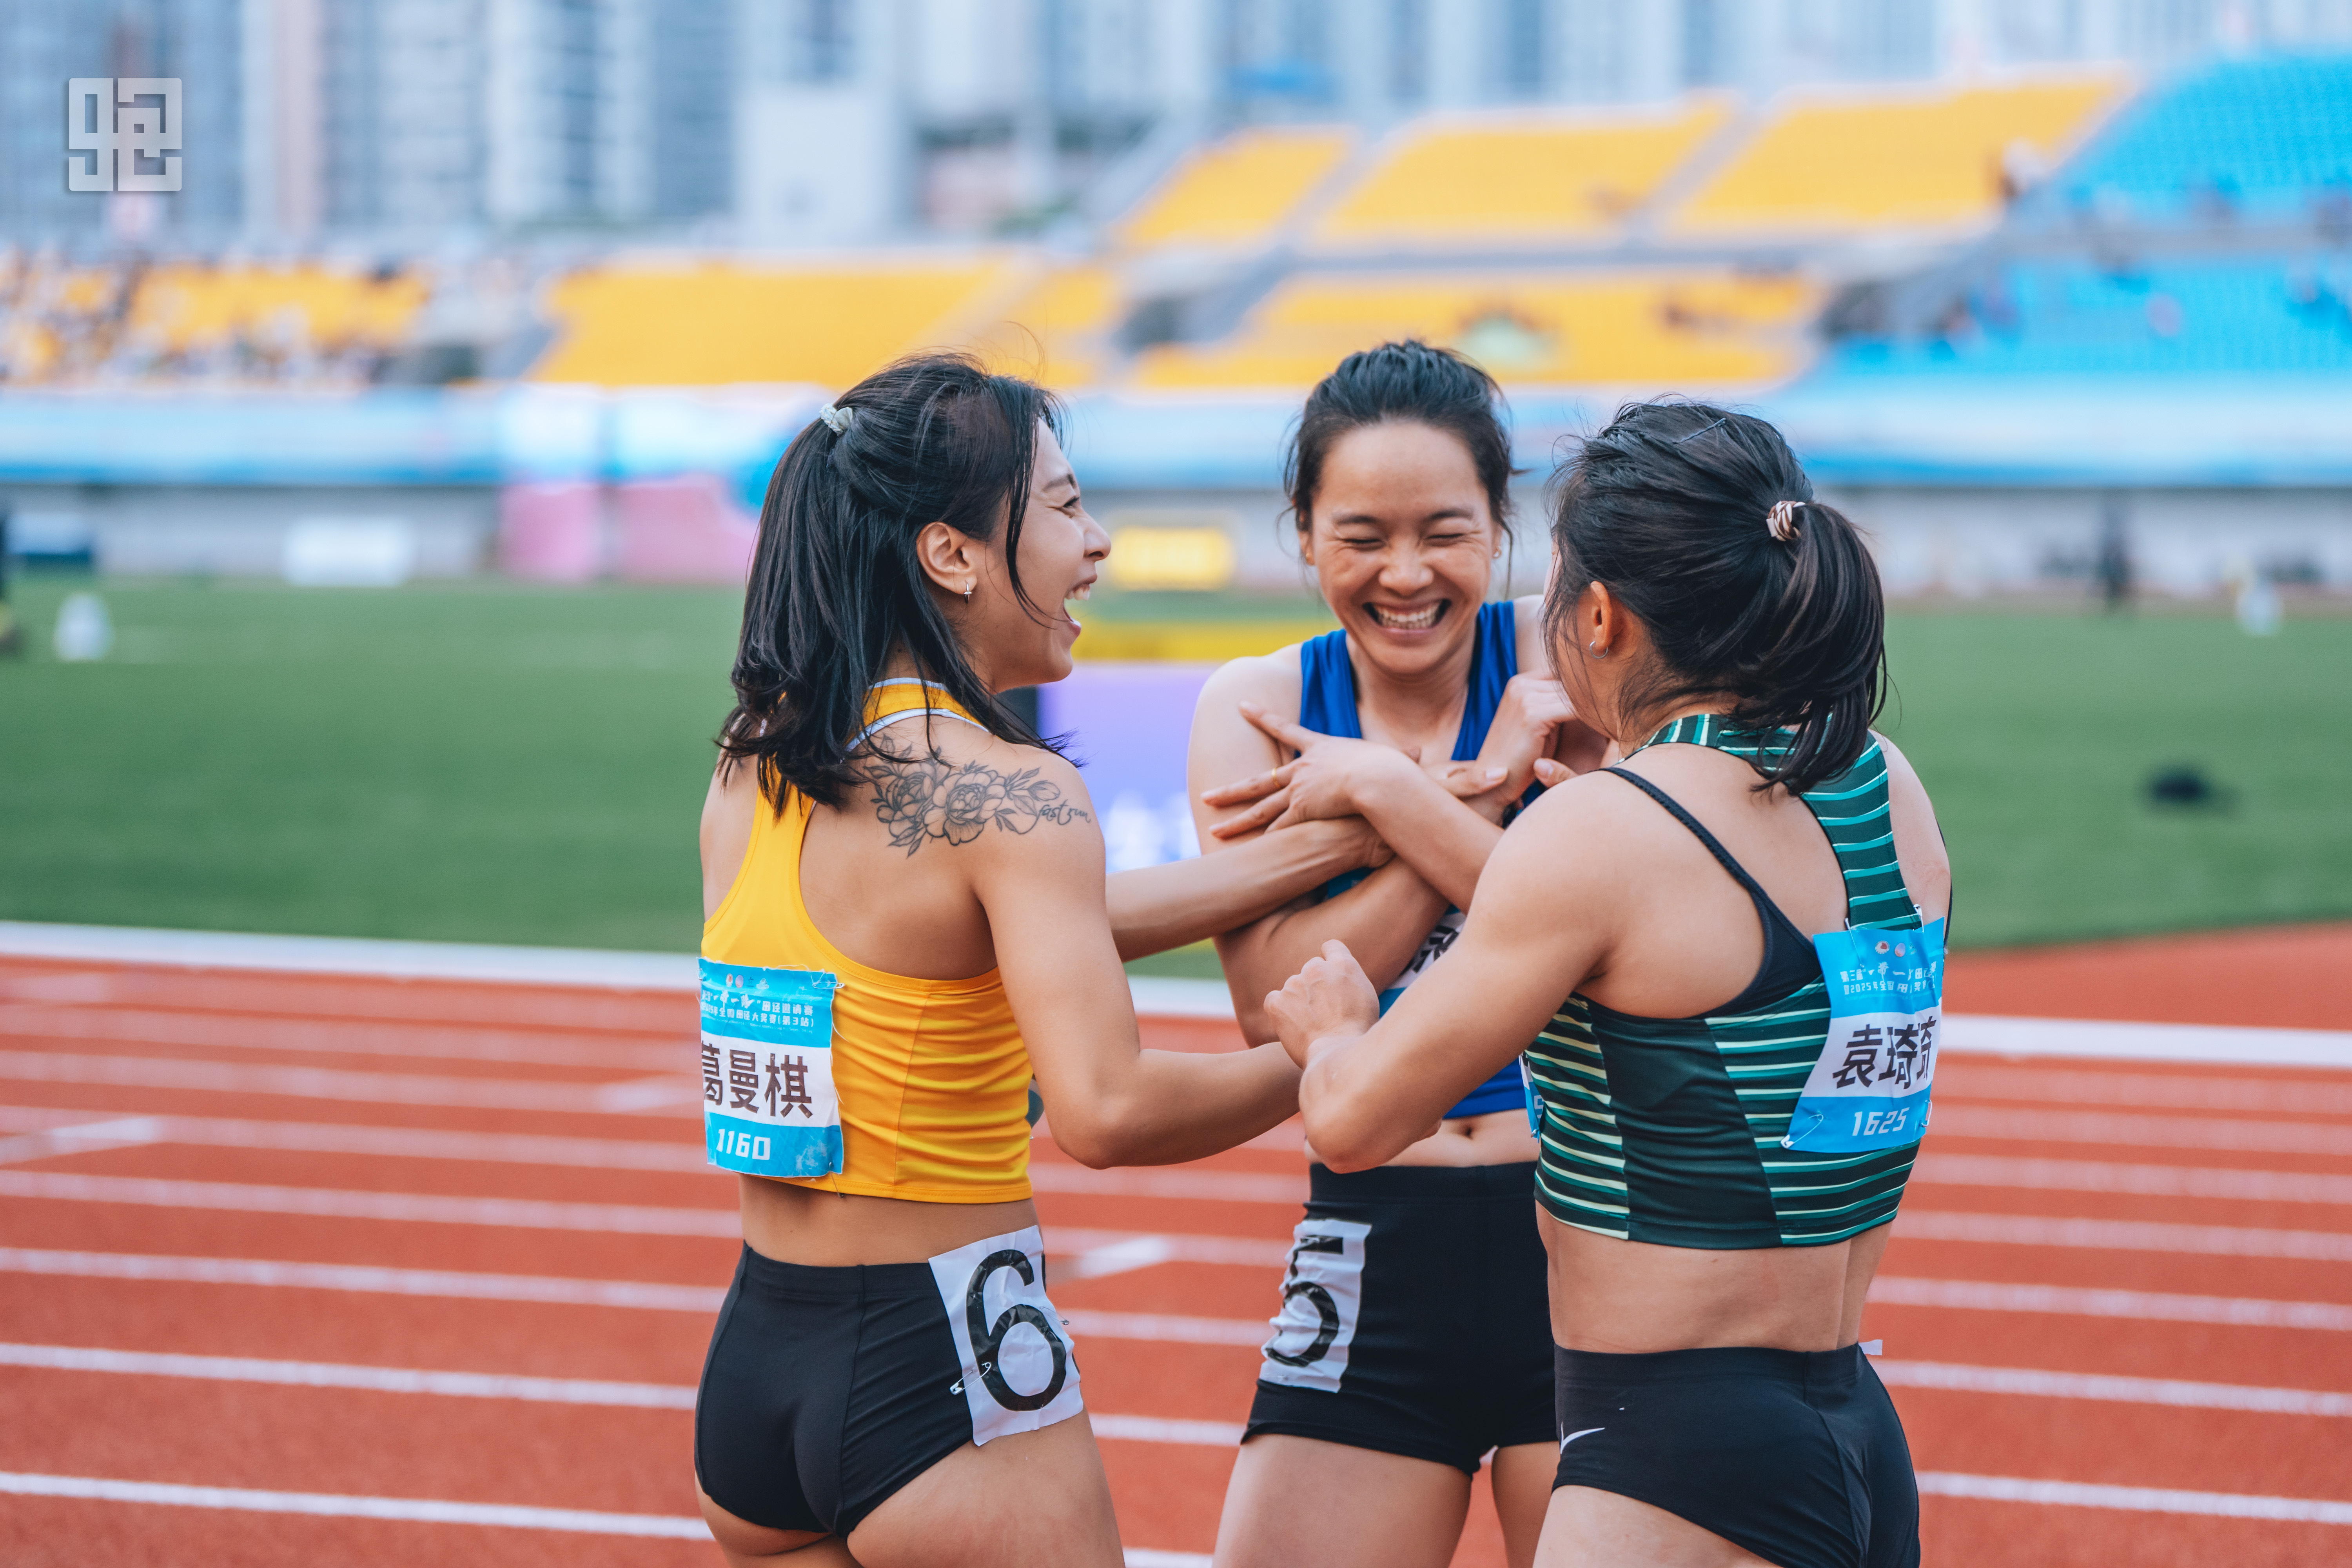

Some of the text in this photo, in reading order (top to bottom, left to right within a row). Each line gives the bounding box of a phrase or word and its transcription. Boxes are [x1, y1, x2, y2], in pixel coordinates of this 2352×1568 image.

[701, 1040, 813, 1118] 葛曼棋
[716, 1128, 771, 1161] 1160
[1852, 1107, 1910, 1136] 1625
[966, 1249, 1066, 1412] 6
[1266, 1235, 1343, 1367] 5
